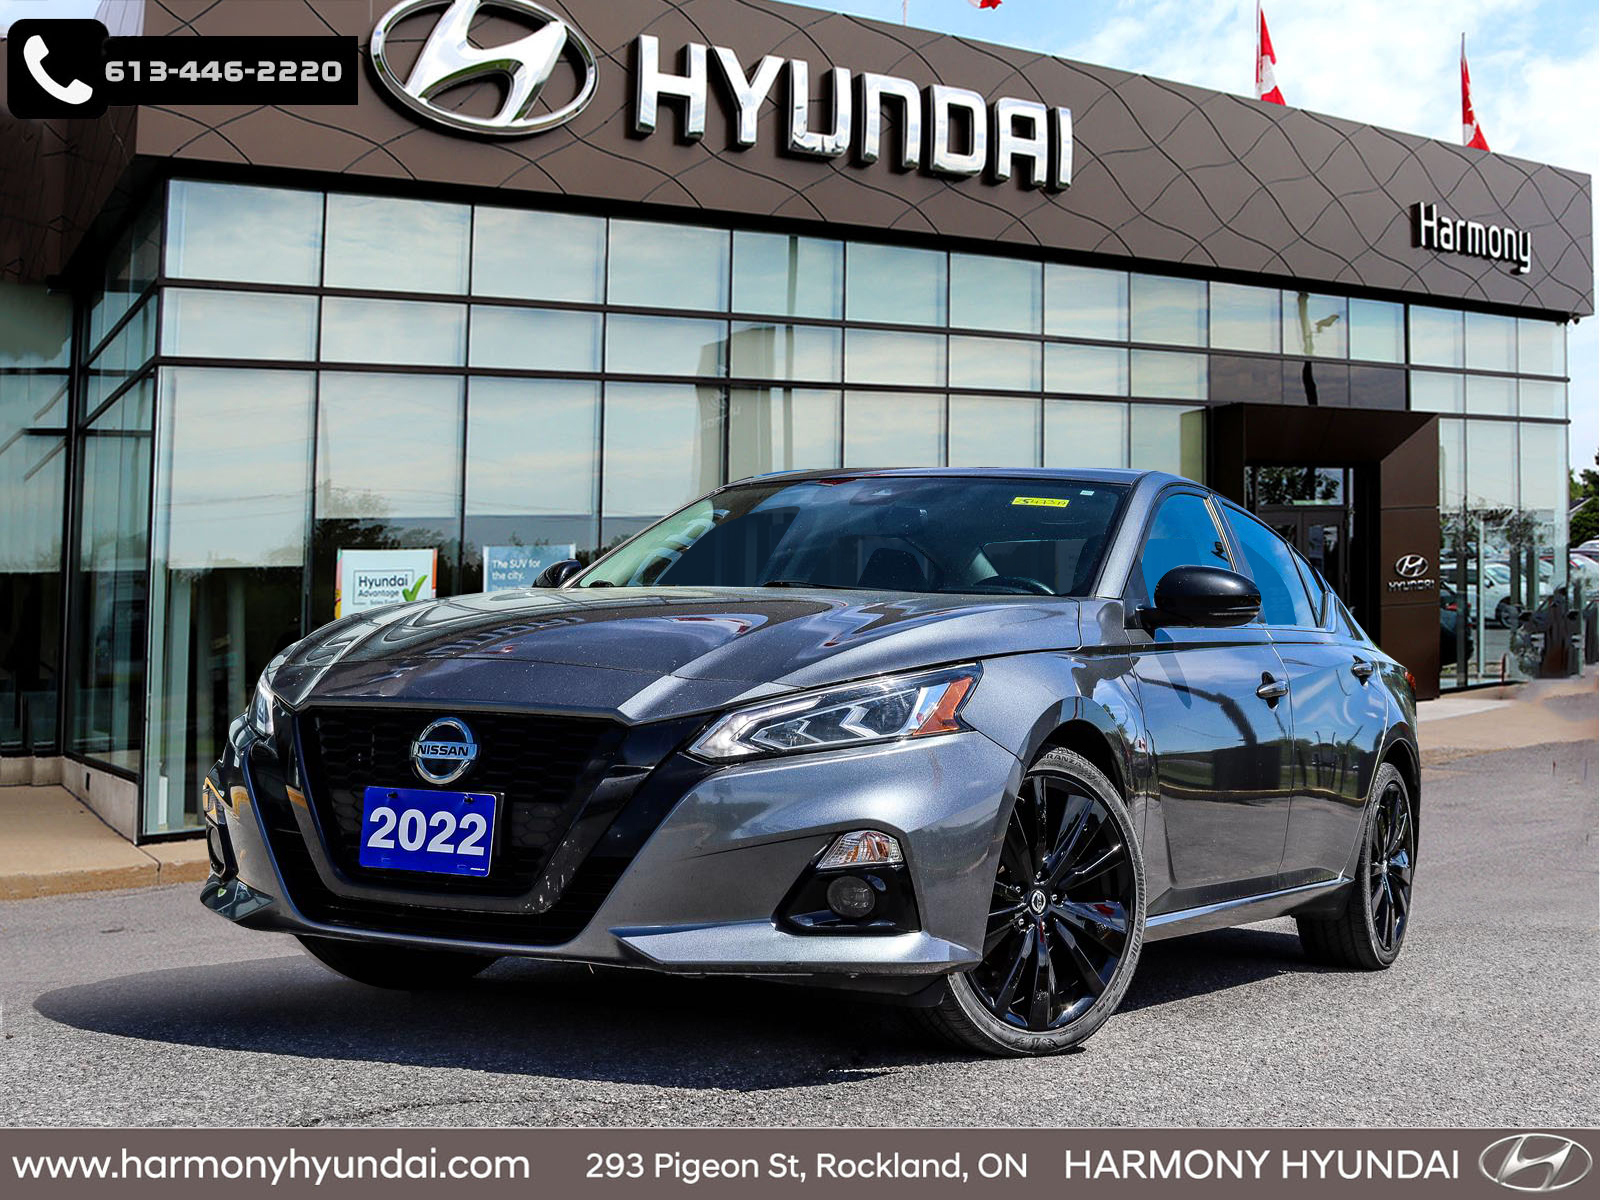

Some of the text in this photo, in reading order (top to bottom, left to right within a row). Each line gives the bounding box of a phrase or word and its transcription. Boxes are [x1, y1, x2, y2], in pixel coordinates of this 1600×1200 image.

[634, 34, 1073, 191] HYUNDAI
[1419, 201, 1531, 274] Harmony
[492, 559, 508, 568] The
[510, 559, 527, 568] SUV
[358, 574, 408, 589] Hyundai
[492, 570, 505, 580] the
[417, 745, 469, 756] NISSAN
[367, 806, 487, 856] 2022
